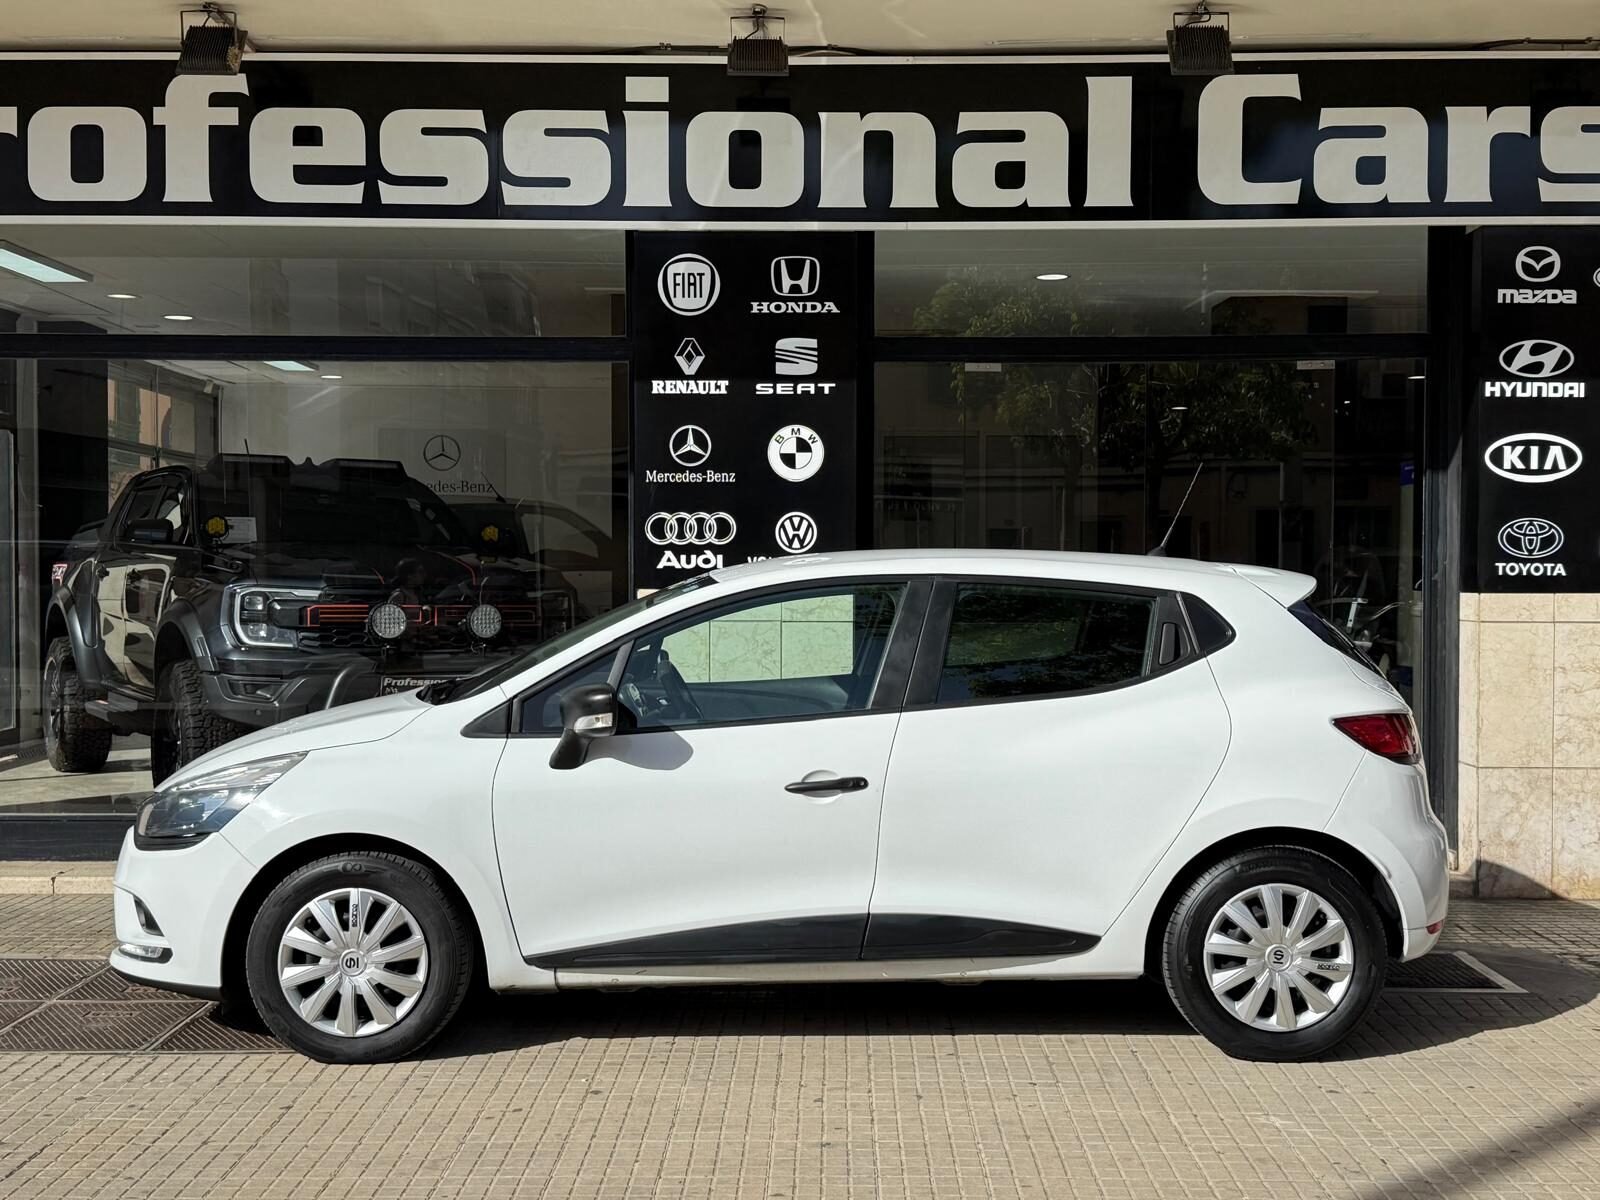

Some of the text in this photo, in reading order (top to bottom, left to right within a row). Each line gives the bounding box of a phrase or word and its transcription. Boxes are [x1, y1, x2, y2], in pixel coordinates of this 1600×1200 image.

[0, 73, 1600, 207] ofessional Cars
[673, 272, 706, 299] FIAT
[750, 301, 841, 314] HONDA
[651, 379, 729, 395] RENAULT
[755, 383, 836, 395] SEAT
[1484, 381, 1586, 398] HYUNDAI
[774, 427, 819, 445] BMW
[1502, 445, 1567, 470] KIA
[645, 469, 736, 483] Mercedes-Benz
[426, 480, 494, 493] edes-Benz
[656, 550, 724, 569] Audi
[1494, 562, 1567, 577] TOYOTA
